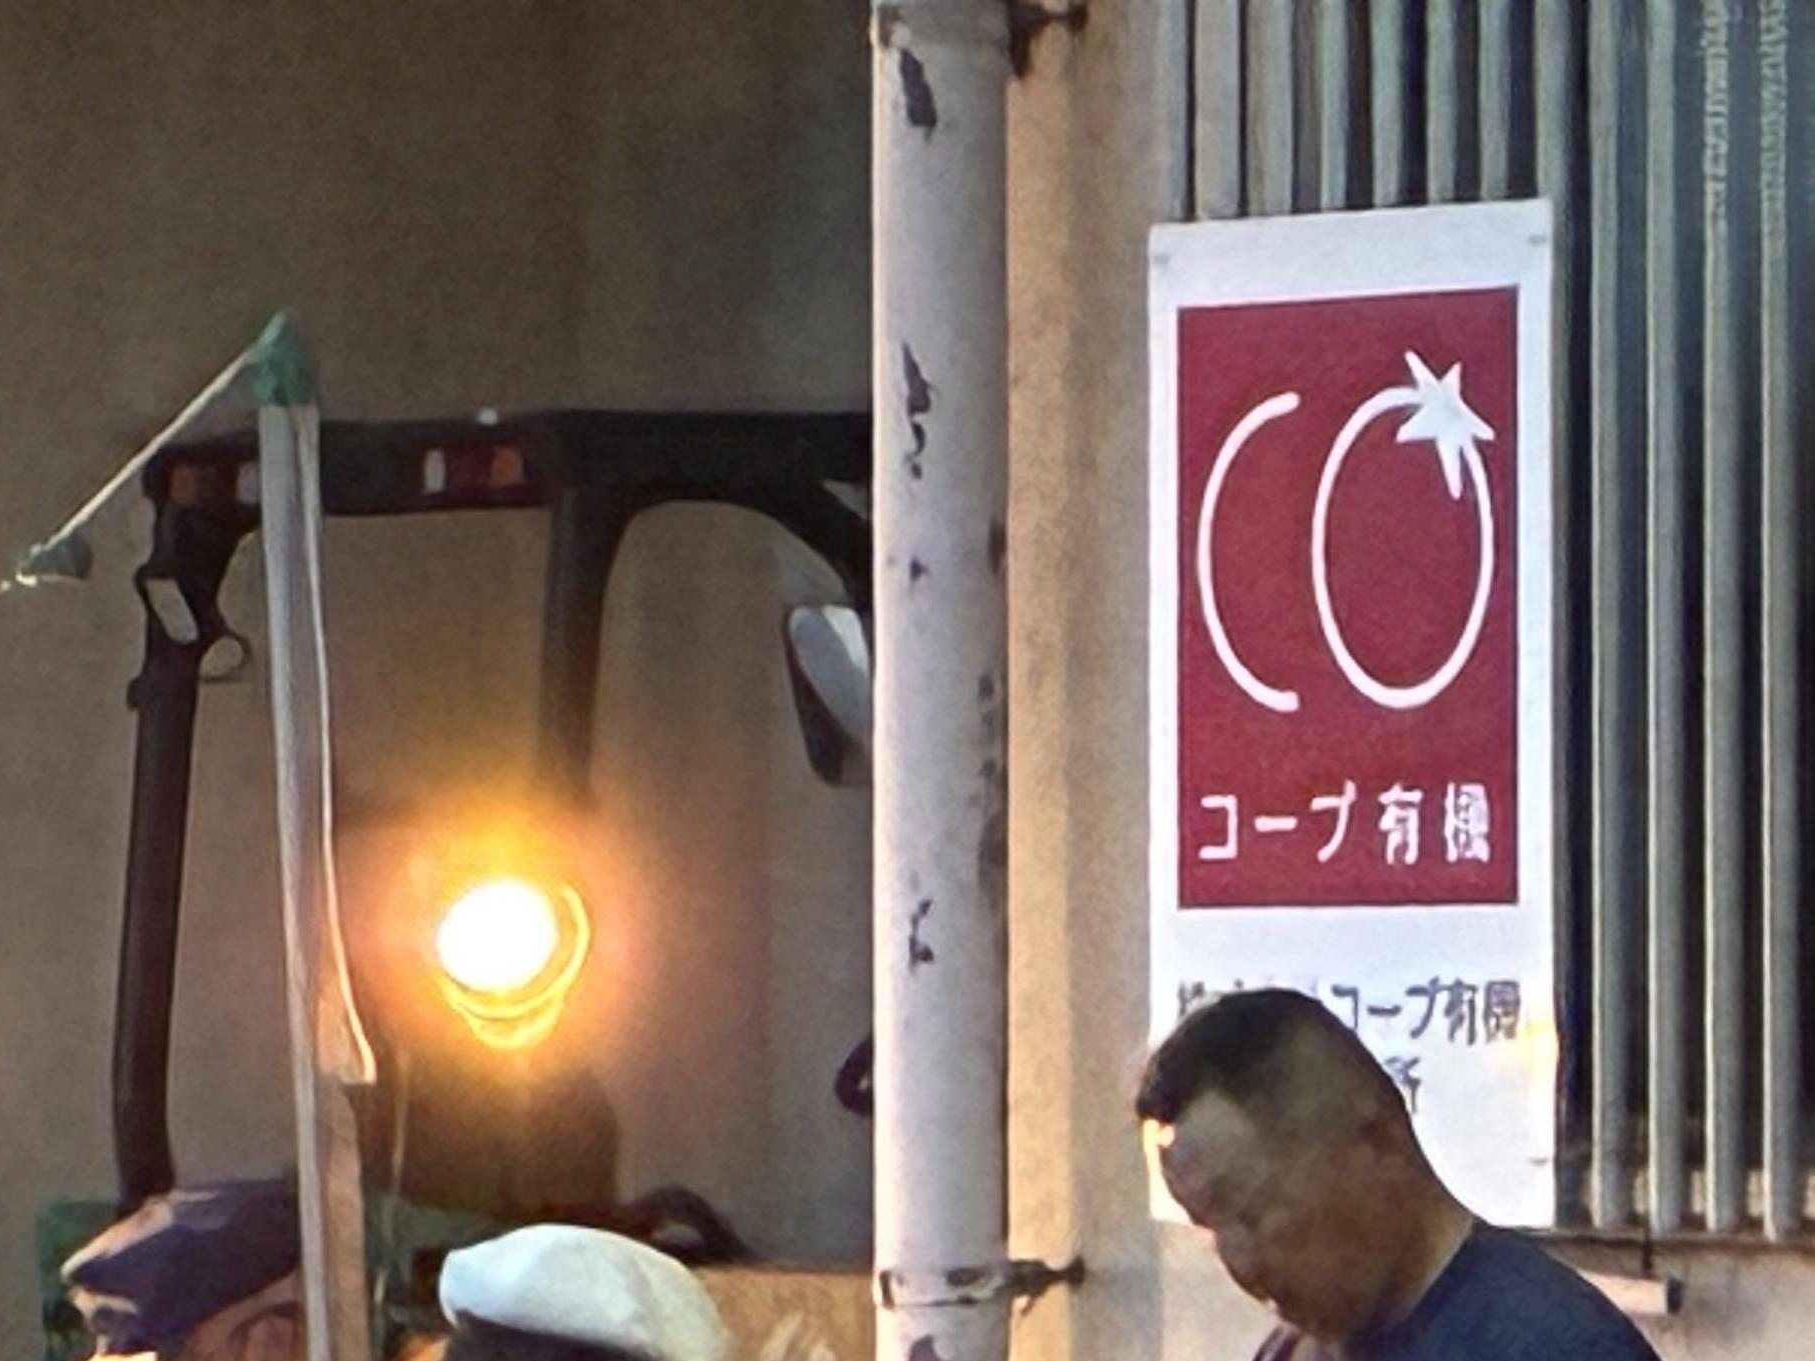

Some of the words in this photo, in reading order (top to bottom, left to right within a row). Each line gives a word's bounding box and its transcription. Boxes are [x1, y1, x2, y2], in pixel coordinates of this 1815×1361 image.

[1198, 779, 1490, 865] コープ有機
